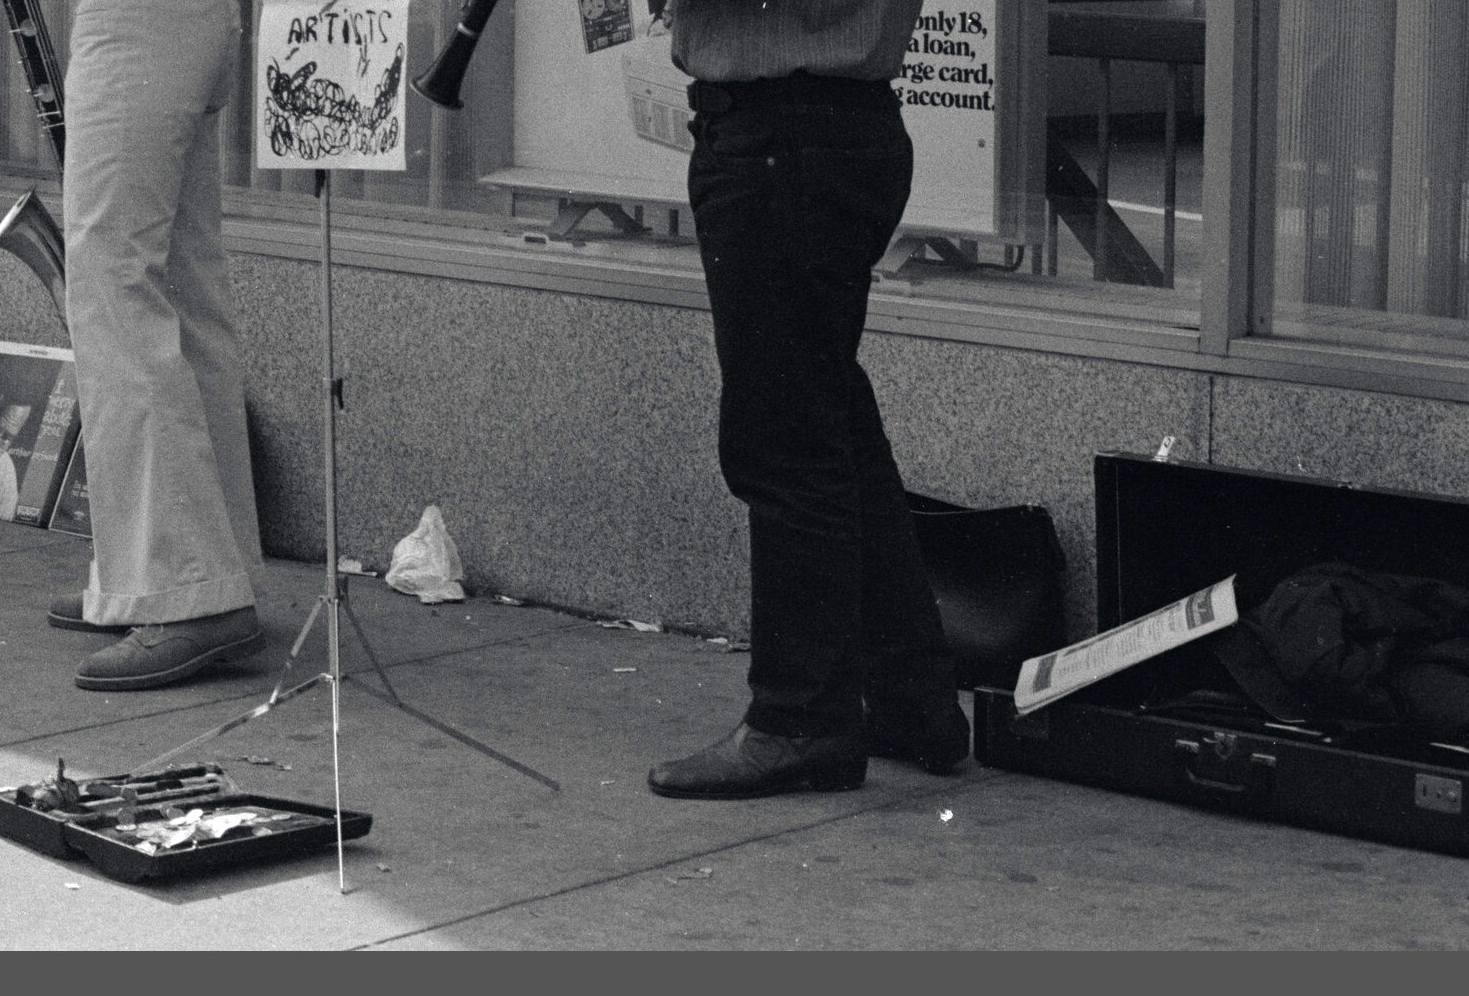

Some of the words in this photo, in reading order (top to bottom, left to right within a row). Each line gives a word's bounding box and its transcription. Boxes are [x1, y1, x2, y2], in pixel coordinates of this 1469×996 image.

[288, 10, 392, 45] ARTISTS
[914, 10, 957, 36] only
[959, 11, 988, 39] 18,
[907, 37, 920, 53] a
[923, 33, 976, 61] loan,
[938, 63, 994, 89] card,
[906, 90, 996, 111] account.
